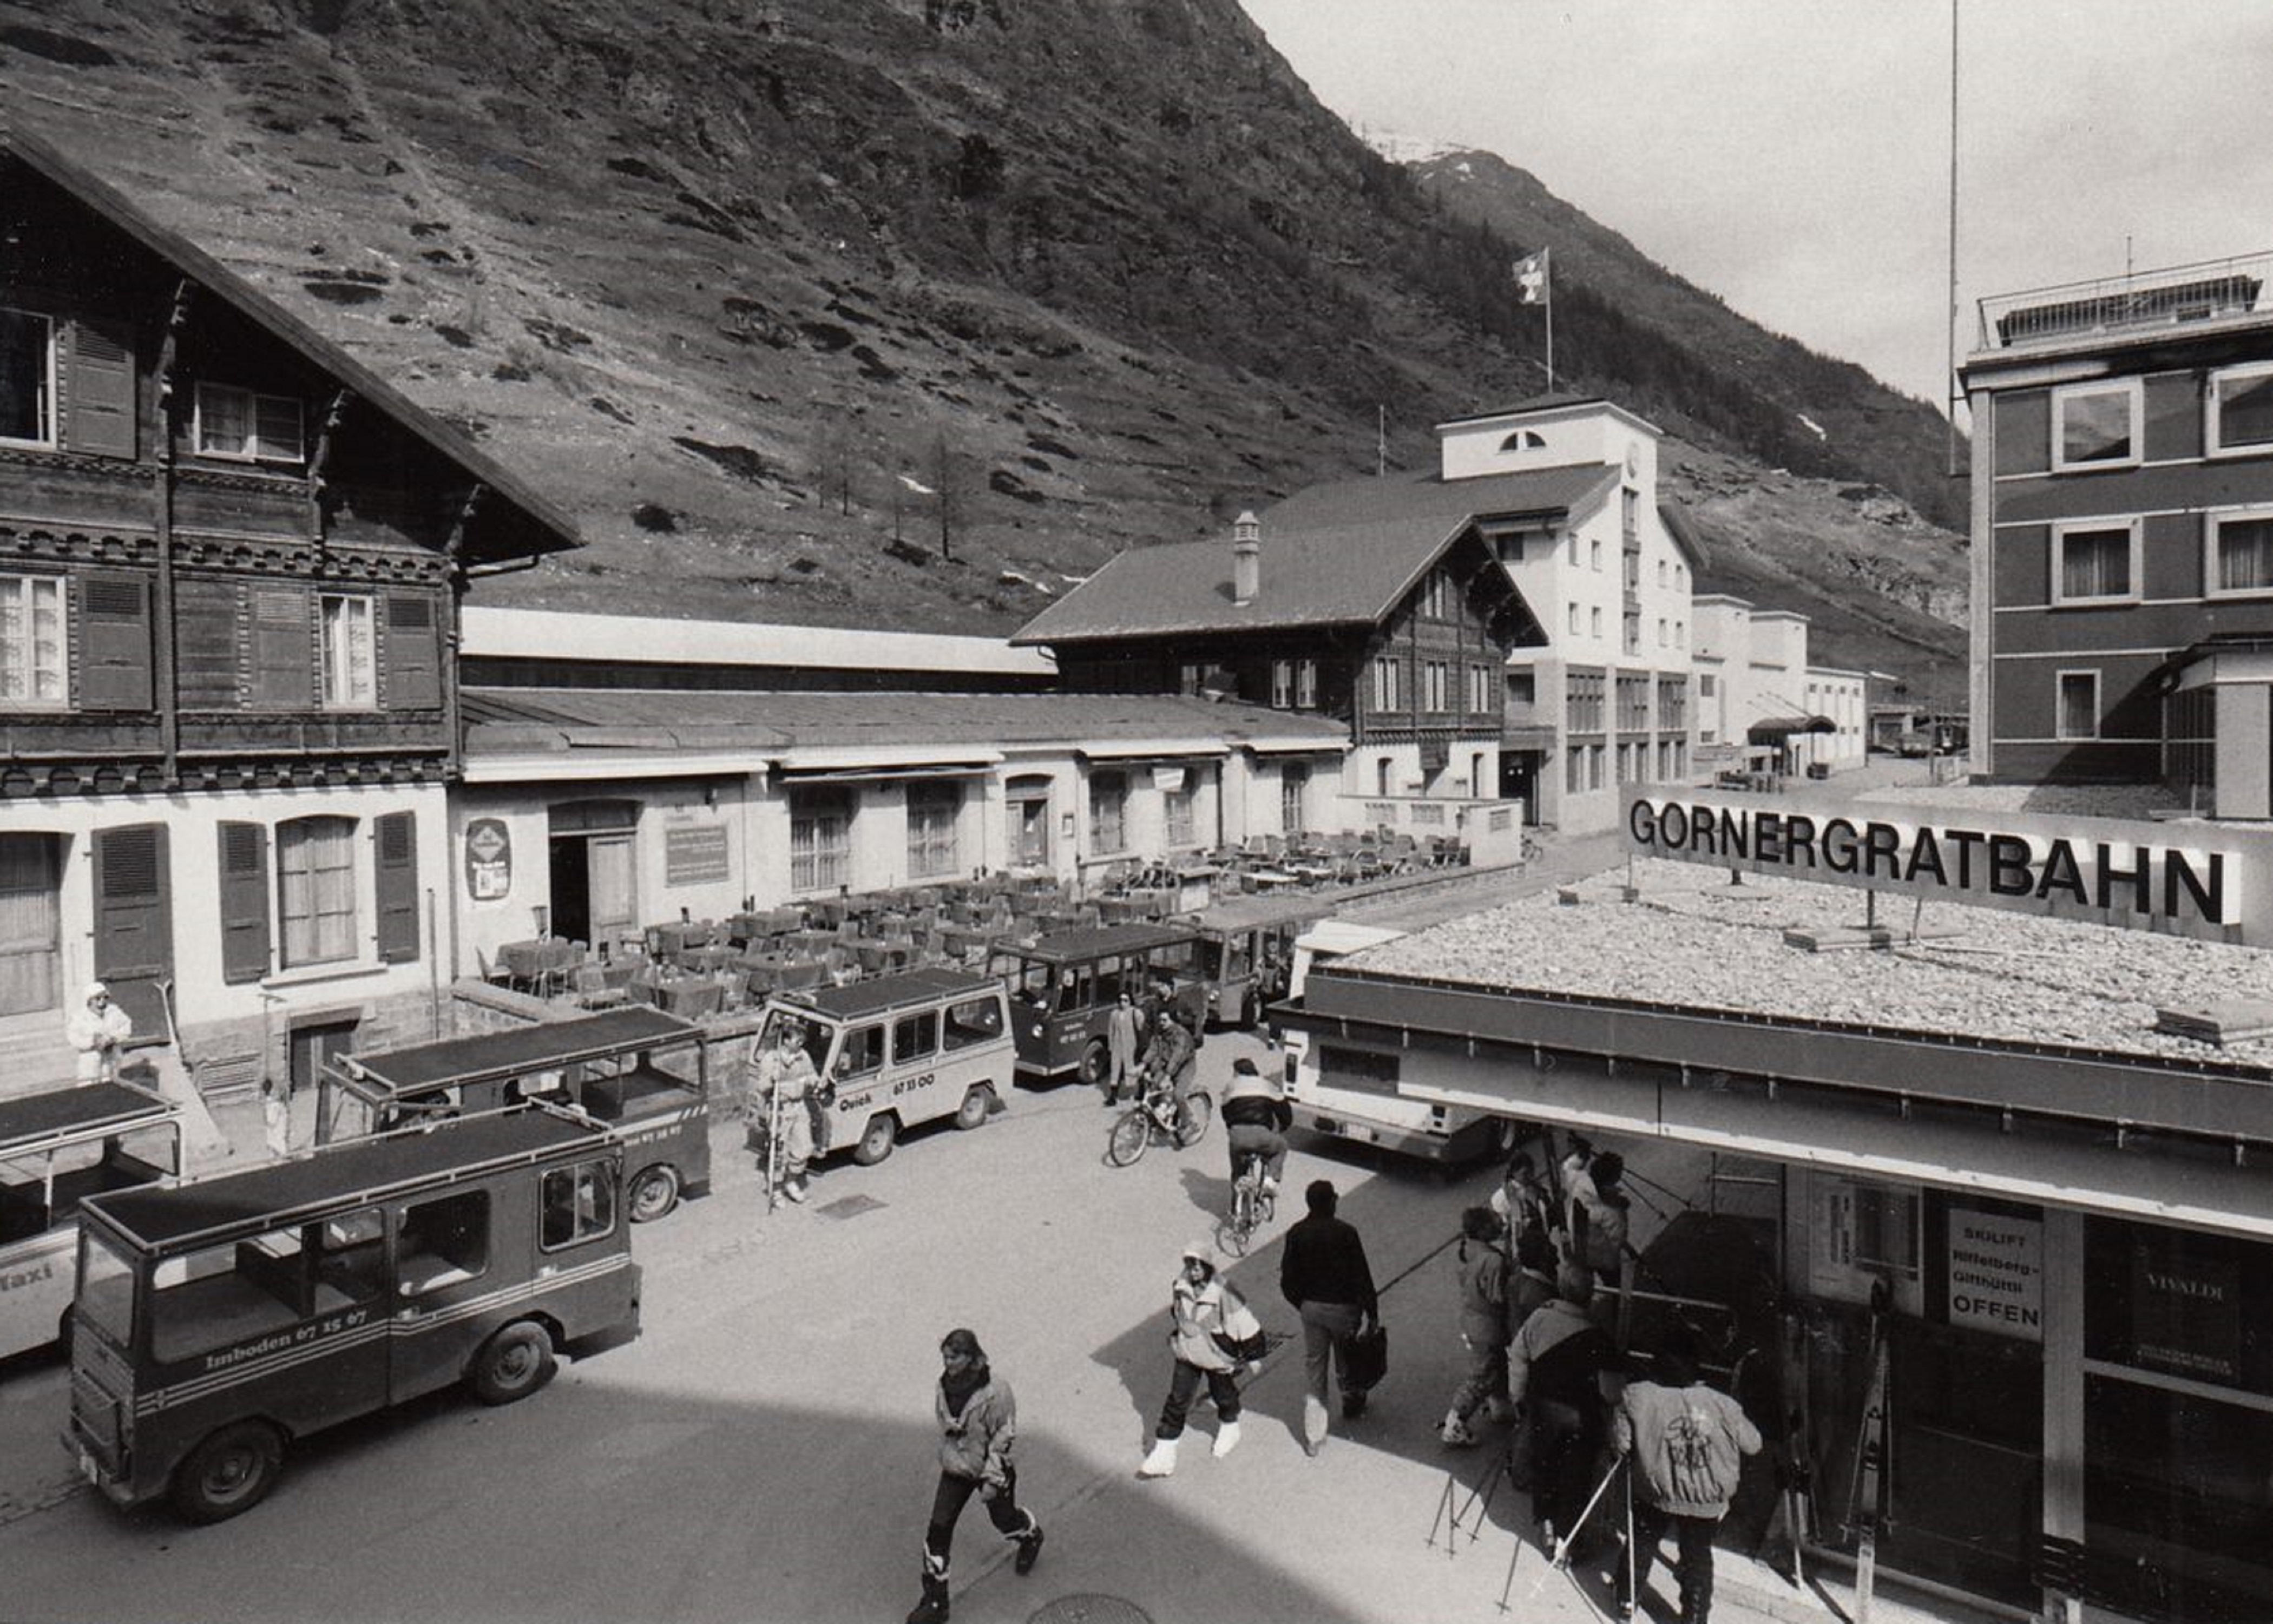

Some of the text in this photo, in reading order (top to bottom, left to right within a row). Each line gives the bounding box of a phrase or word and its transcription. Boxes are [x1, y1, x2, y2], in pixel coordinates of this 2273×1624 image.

[1630, 799, 2224, 924] GORNERGRATBAHN
[1965, 1227, 2026, 1248] SKILIFT
[1954, 1295, 2038, 1326] OFFEN
[206, 1334, 291, 1370] Imboden
[296, 1325, 317, 1340] 67
